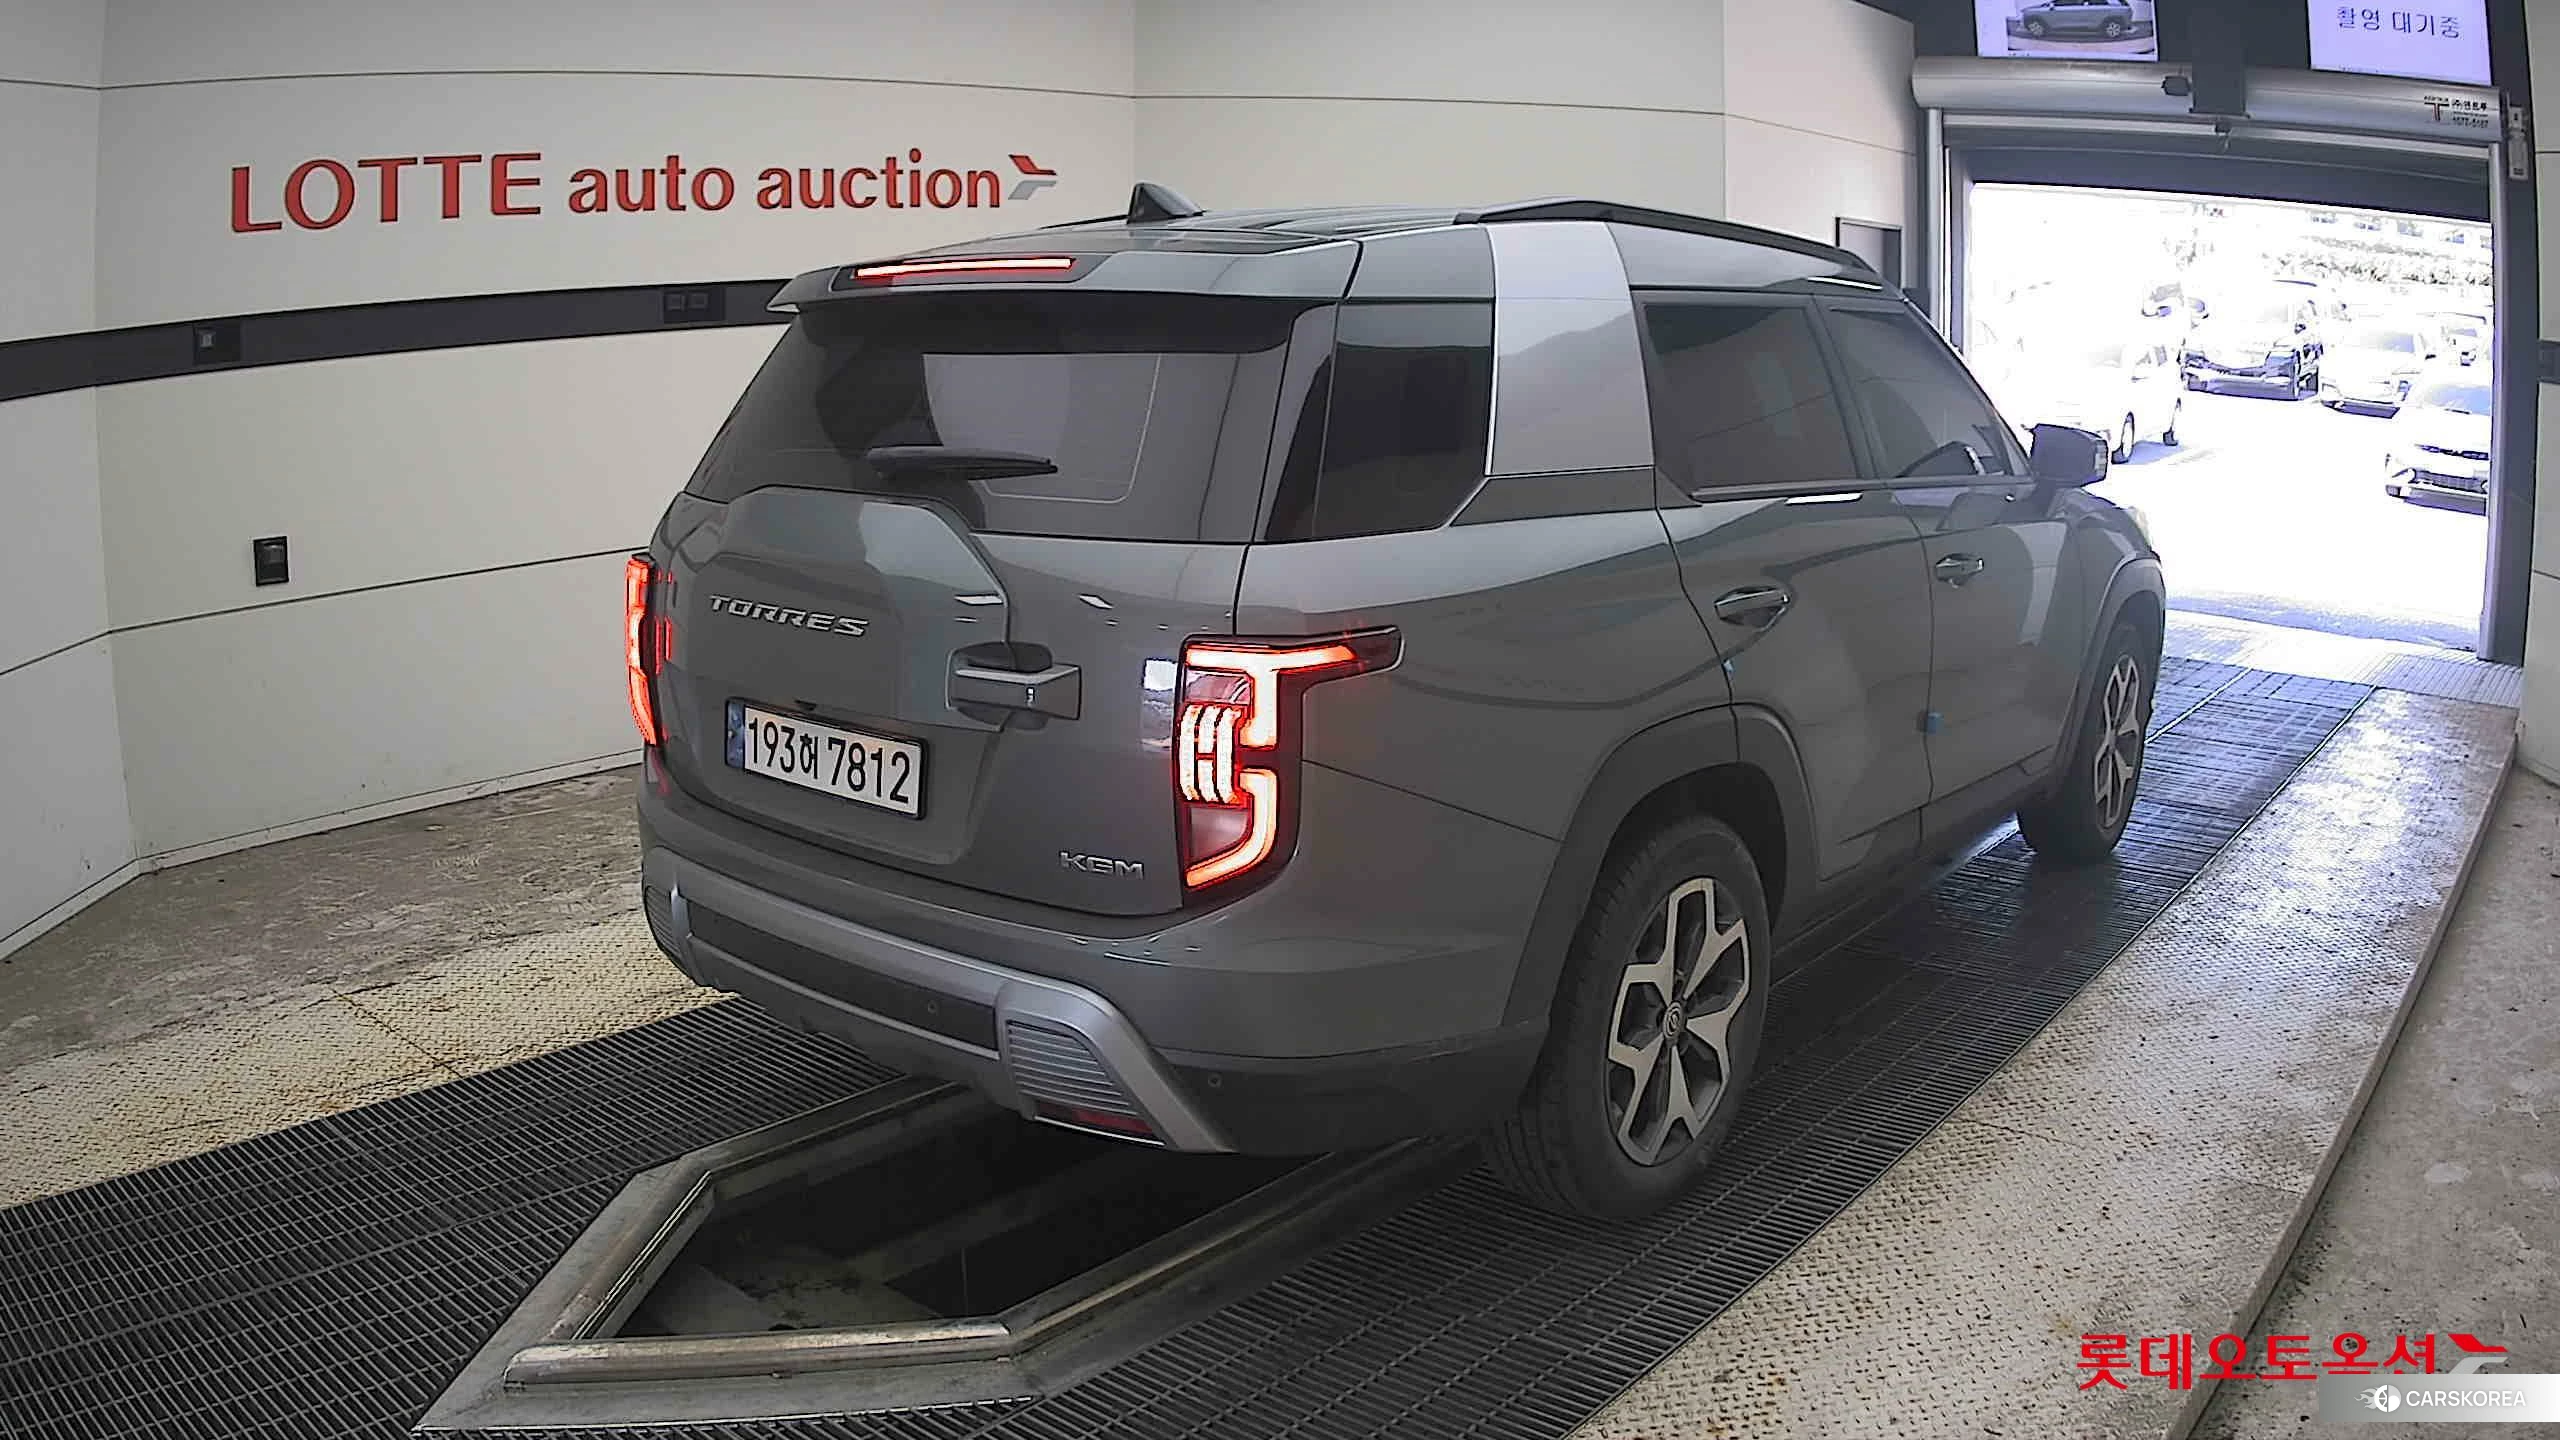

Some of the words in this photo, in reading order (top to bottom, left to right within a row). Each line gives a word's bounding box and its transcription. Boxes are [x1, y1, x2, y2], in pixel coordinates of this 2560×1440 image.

[2337, 6, 2380, 31] 촬영
[2392, 11, 2460, 39] 대기중
[231, 152, 542, 233] LOTTE
[568, 154, 735, 213] auto
[756, 147, 1001, 209] auction
[709, 594, 869, 637] TORRES
[827, 736, 911, 804] 7812
